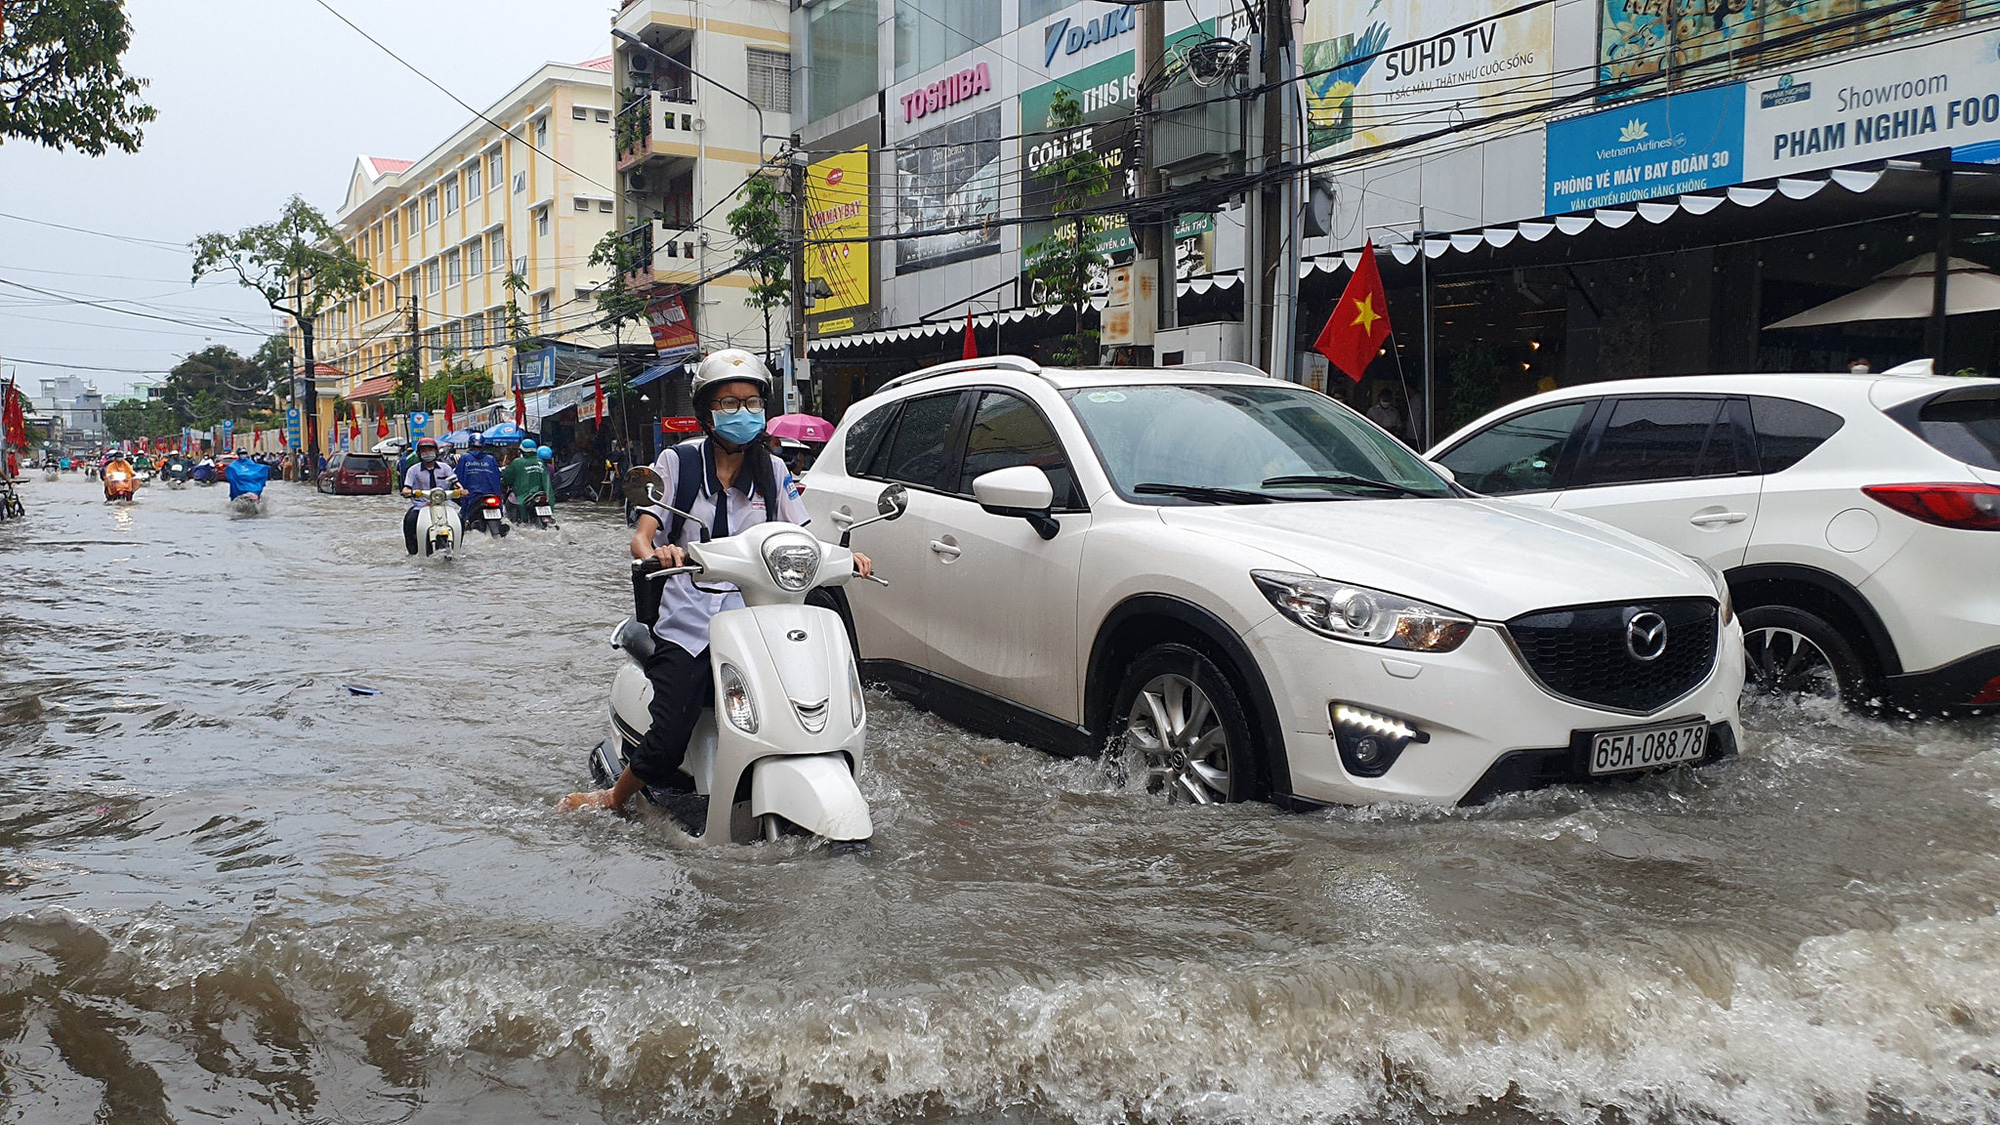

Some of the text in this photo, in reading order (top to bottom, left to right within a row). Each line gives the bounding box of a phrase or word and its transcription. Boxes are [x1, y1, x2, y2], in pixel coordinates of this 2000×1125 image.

[1386, 22, 1497, 81] SUHD TV
[1459, 66, 1478, 82] NHƯ
[1480, 60, 1505, 76] CUỘC
[1507, 53, 1534, 70] SỐNG
[901, 62, 990, 122] TOSHIBA
[1083, 73, 1135, 113] THIS IS
[1838, 74, 1947, 112] Showroom
[1773, 93, 2000, 160] PHAM NGHIA FOO
[1596, 138, 1673, 160] Vietnam Airlines
[1554, 151, 1729, 196] PHÒNG VÉ MÁY BAY ĐOÀN 30
[1651, 184, 1674, 198] HÀNG
[1677, 178, 1707, 194] KHÔNG
[1596, 727, 1703, 768] 65A-088.78
